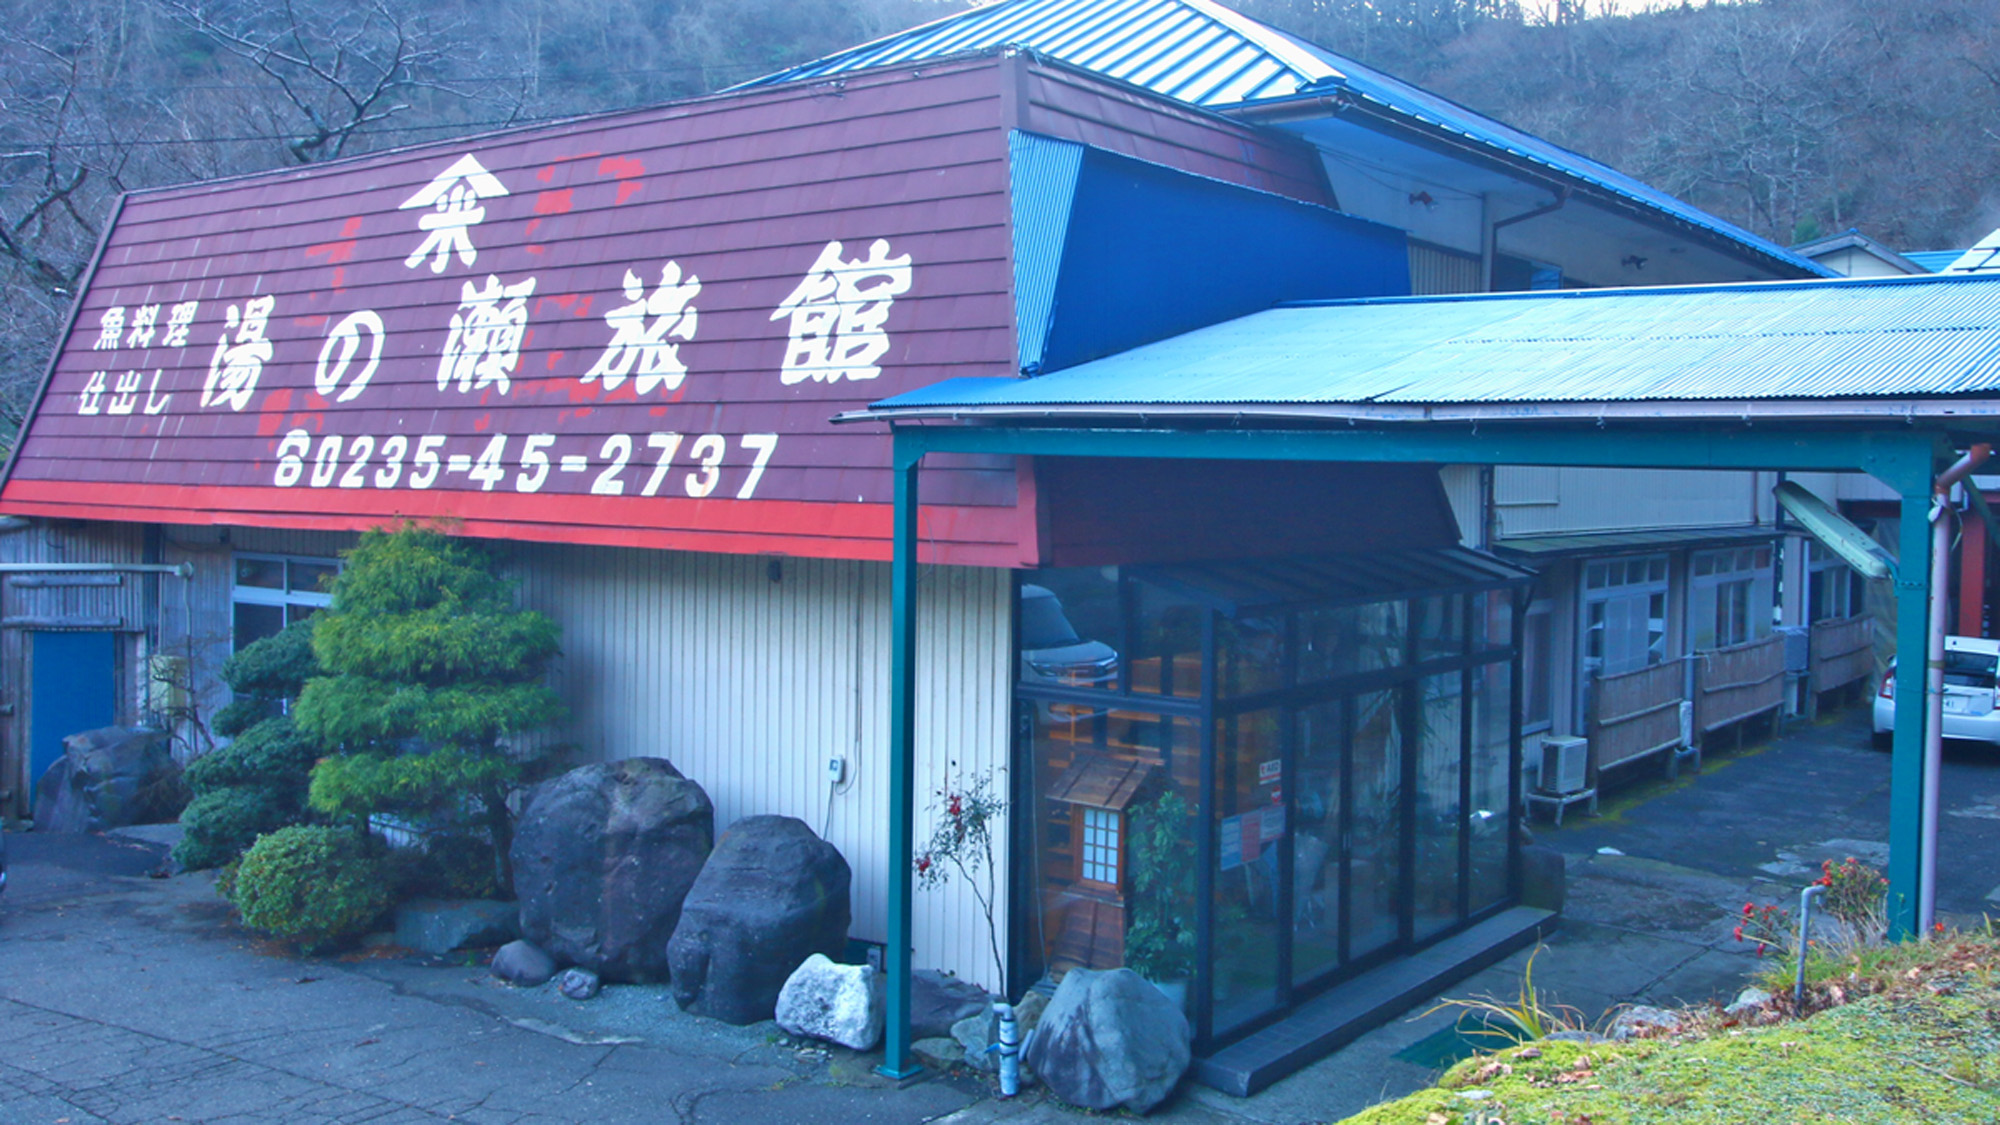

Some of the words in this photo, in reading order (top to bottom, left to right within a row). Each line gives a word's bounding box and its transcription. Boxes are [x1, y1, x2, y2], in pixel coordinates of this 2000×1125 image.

[93, 301, 199, 350] 魚料理
[78, 369, 171, 415] 仕出し
